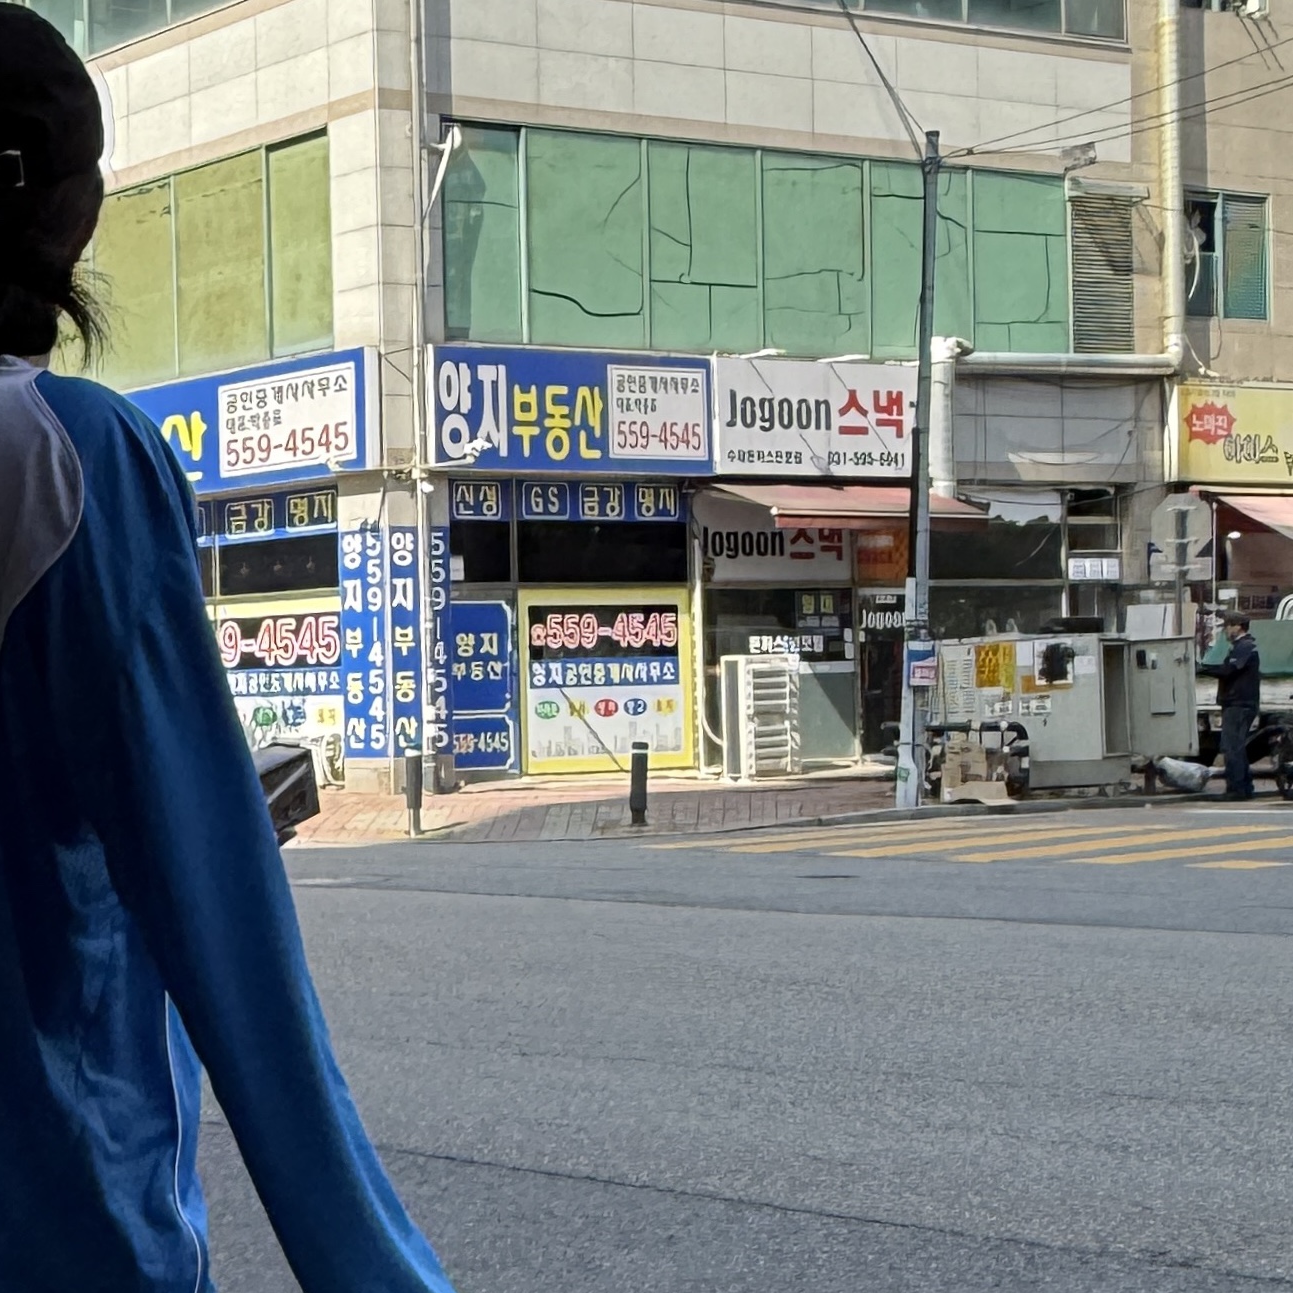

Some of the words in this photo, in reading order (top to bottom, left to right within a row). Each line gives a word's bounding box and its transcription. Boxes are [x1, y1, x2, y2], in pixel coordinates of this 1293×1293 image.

[226, 374, 348, 414] 공인중개사사무소
[439, 360, 508, 459] 양지
[512, 383, 604, 461] 부동산
[726, 388, 832, 433] Jogoon
[838, 388, 904, 439] 스낵
[226, 420, 349, 468] 559-4545
[616, 420, 702, 451] 559-4545
[229, 500, 272, 534] 금강
[289, 493, 332, 527] 명지
[530, 486, 559, 514] GS
[583, 486, 621, 517] 금강
[638, 486, 675, 517] 명지
[702, 526, 785, 560] Jogoon
[790, 528, 844, 561] 스낵
[455, 632, 499, 657] 양지
[546, 612, 679, 650] 559-4545
[452, 731, 509, 755] 559-4545
